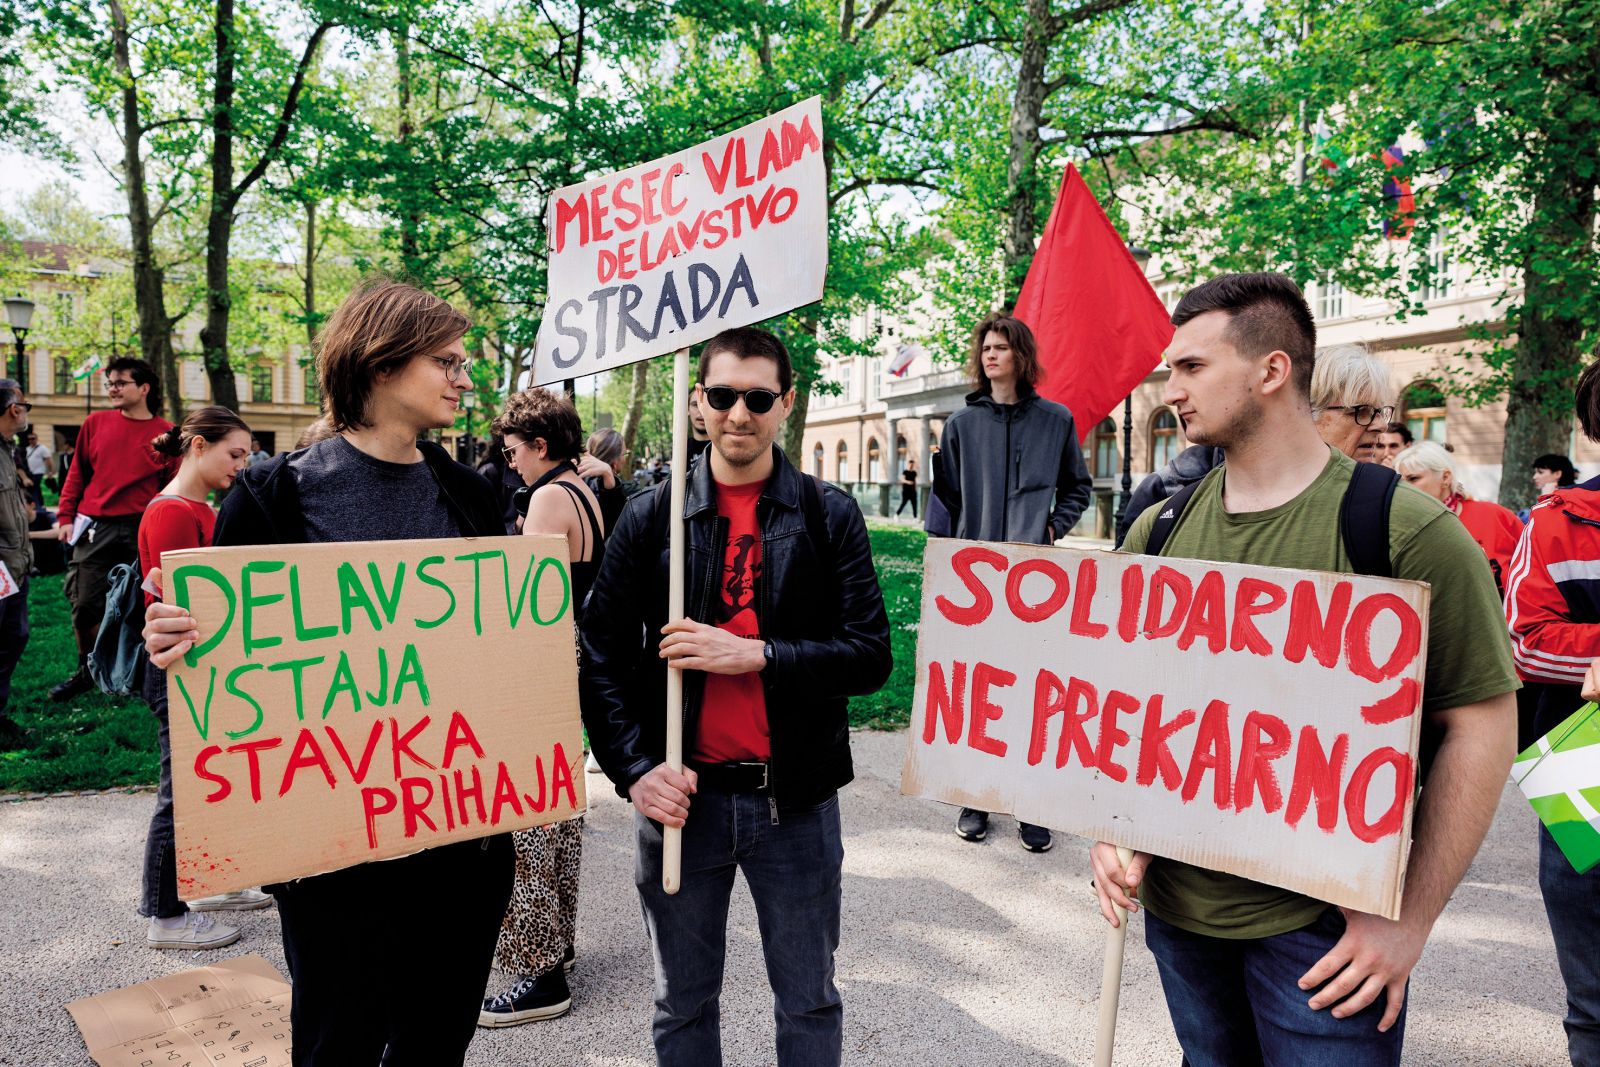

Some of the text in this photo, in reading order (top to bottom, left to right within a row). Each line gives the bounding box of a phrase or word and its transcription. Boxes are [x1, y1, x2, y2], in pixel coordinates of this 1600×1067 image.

[556, 115, 820, 253] MESEC VLADA
[597, 184, 798, 283] DELAVSTVO
[552, 253, 759, 369] STRADA
[173, 550, 570, 668] DELAVSTVO
[175, 643, 430, 740] VSTAJA
[194, 710, 486, 804] STAVKA
[360, 742, 580, 849] PRIHAJA
[923, 660, 1413, 843] NE PREKARNO
